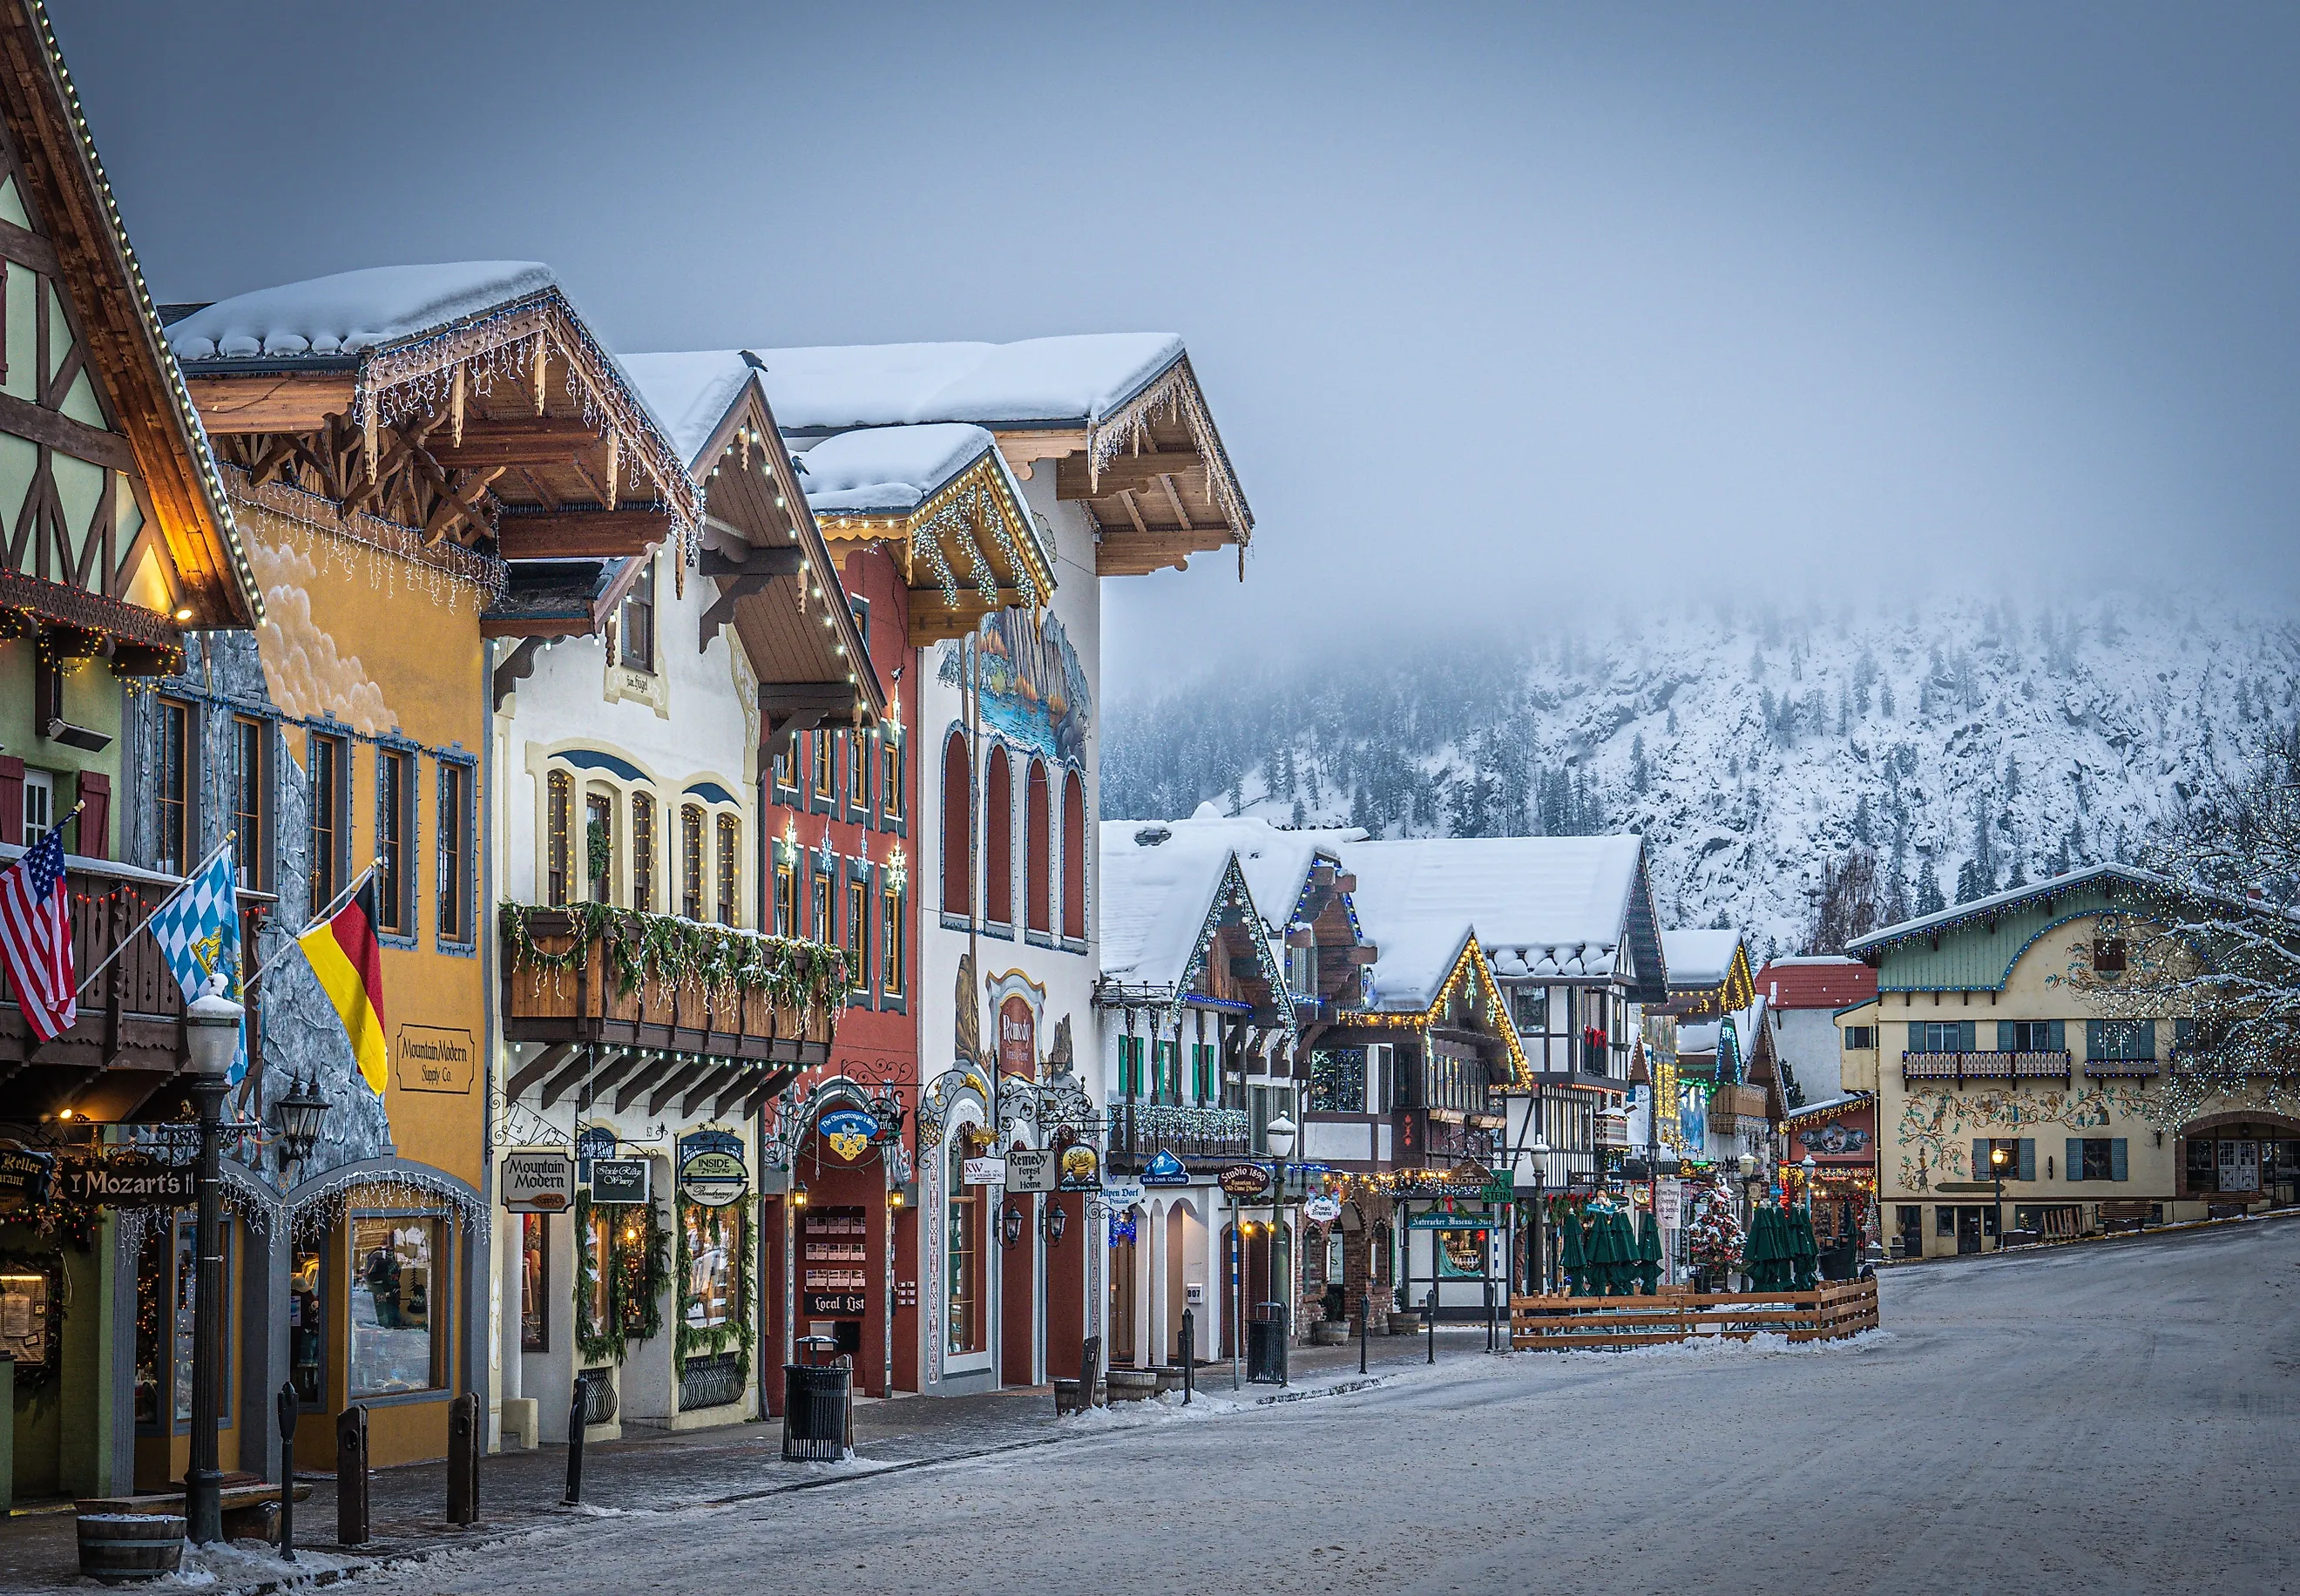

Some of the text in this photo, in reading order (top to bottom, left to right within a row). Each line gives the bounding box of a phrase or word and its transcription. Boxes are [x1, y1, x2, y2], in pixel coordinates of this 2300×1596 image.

[1003, 1014, 1031, 1049] Remedy
[402, 1037, 468, 1062] Mountain Modern
[422, 1064, 452, 1085] Supply Co.
[866, 1117, 878, 1130] Shop
[2, 1153, 42, 1174] Keller
[508, 1159, 565, 1173] Mountain
[698, 1159, 730, 1168] INSIDE
[1010, 1151, 1048, 1167] Remedy
[619, 1166, 643, 1178] Ridge
[964, 1162, 984, 1173] KW
[1018, 1167, 1041, 1175] Forest
[1221, 1166, 1266, 1182] Studio 1890
[85, 1171, 181, 1199] Mozart's
[514, 1173, 565, 1189] Modern
[604, 1174, 635, 1187] Winery
[1019, 1180, 1042, 1189] Home
[692, 1185, 734, 1201] Boudreaux
[1099, 1188, 1139, 1200] Alpen Dorf
[1484, 1191, 1512, 1200] STEIN
[536, 1195, 555, 1206] Supply
[815, 1295, 841, 1311] Local
